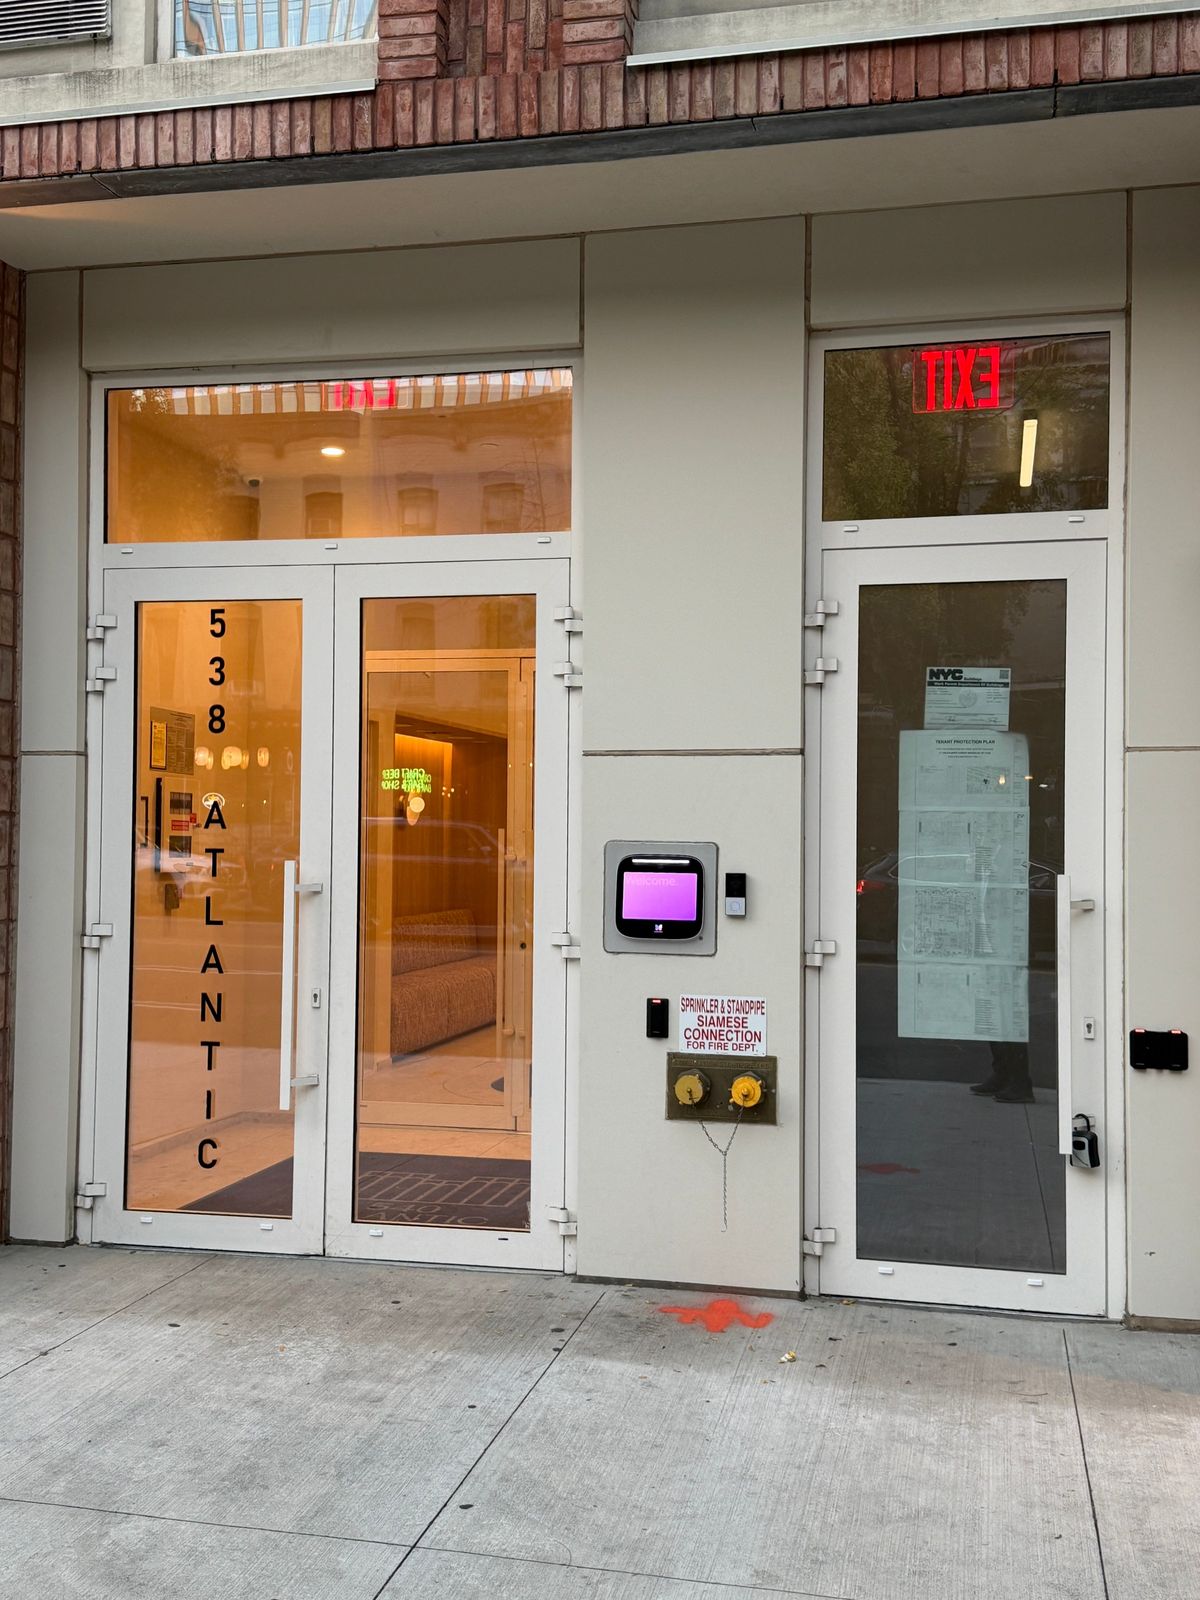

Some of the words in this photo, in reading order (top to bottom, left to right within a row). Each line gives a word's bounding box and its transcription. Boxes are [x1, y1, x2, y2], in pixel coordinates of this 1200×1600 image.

[209, 608, 226, 734] 538
[929, 668, 964, 681] NYC
[198, 800, 227, 1169] ATLANTIC
[681, 997, 718, 1014] SPRINKLER
[720, 999, 725, 1014] &
[727, 999, 765, 1015] STANDPIPE
[697, 1015, 748, 1029] SIAMESE
[683, 1028, 762, 1043] CONNECTION
[686, 1041, 706, 1050] FOR
[708, 1041, 729, 1051] FIRE
